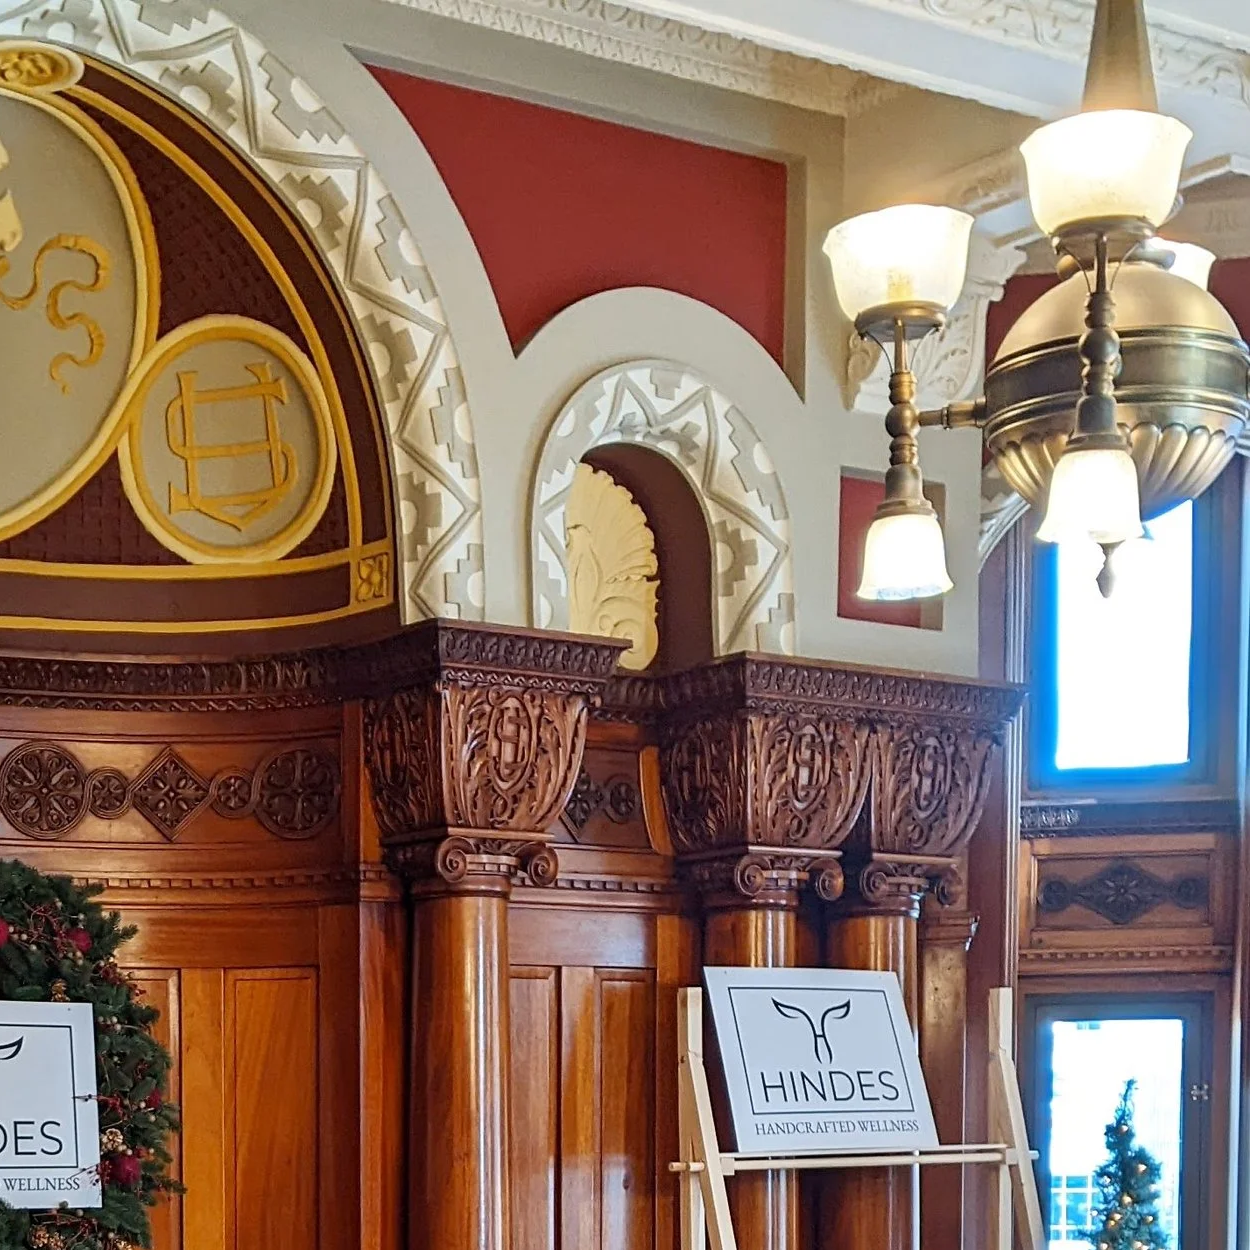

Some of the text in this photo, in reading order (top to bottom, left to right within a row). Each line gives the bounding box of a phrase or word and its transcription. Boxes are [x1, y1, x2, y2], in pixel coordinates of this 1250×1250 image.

[760, 1070, 901, 1103] HINDES
[755, 1119, 920, 1136] HANDCRAFTED WELLNESS
[4, 1176, 81, 1192] WELLNESS
